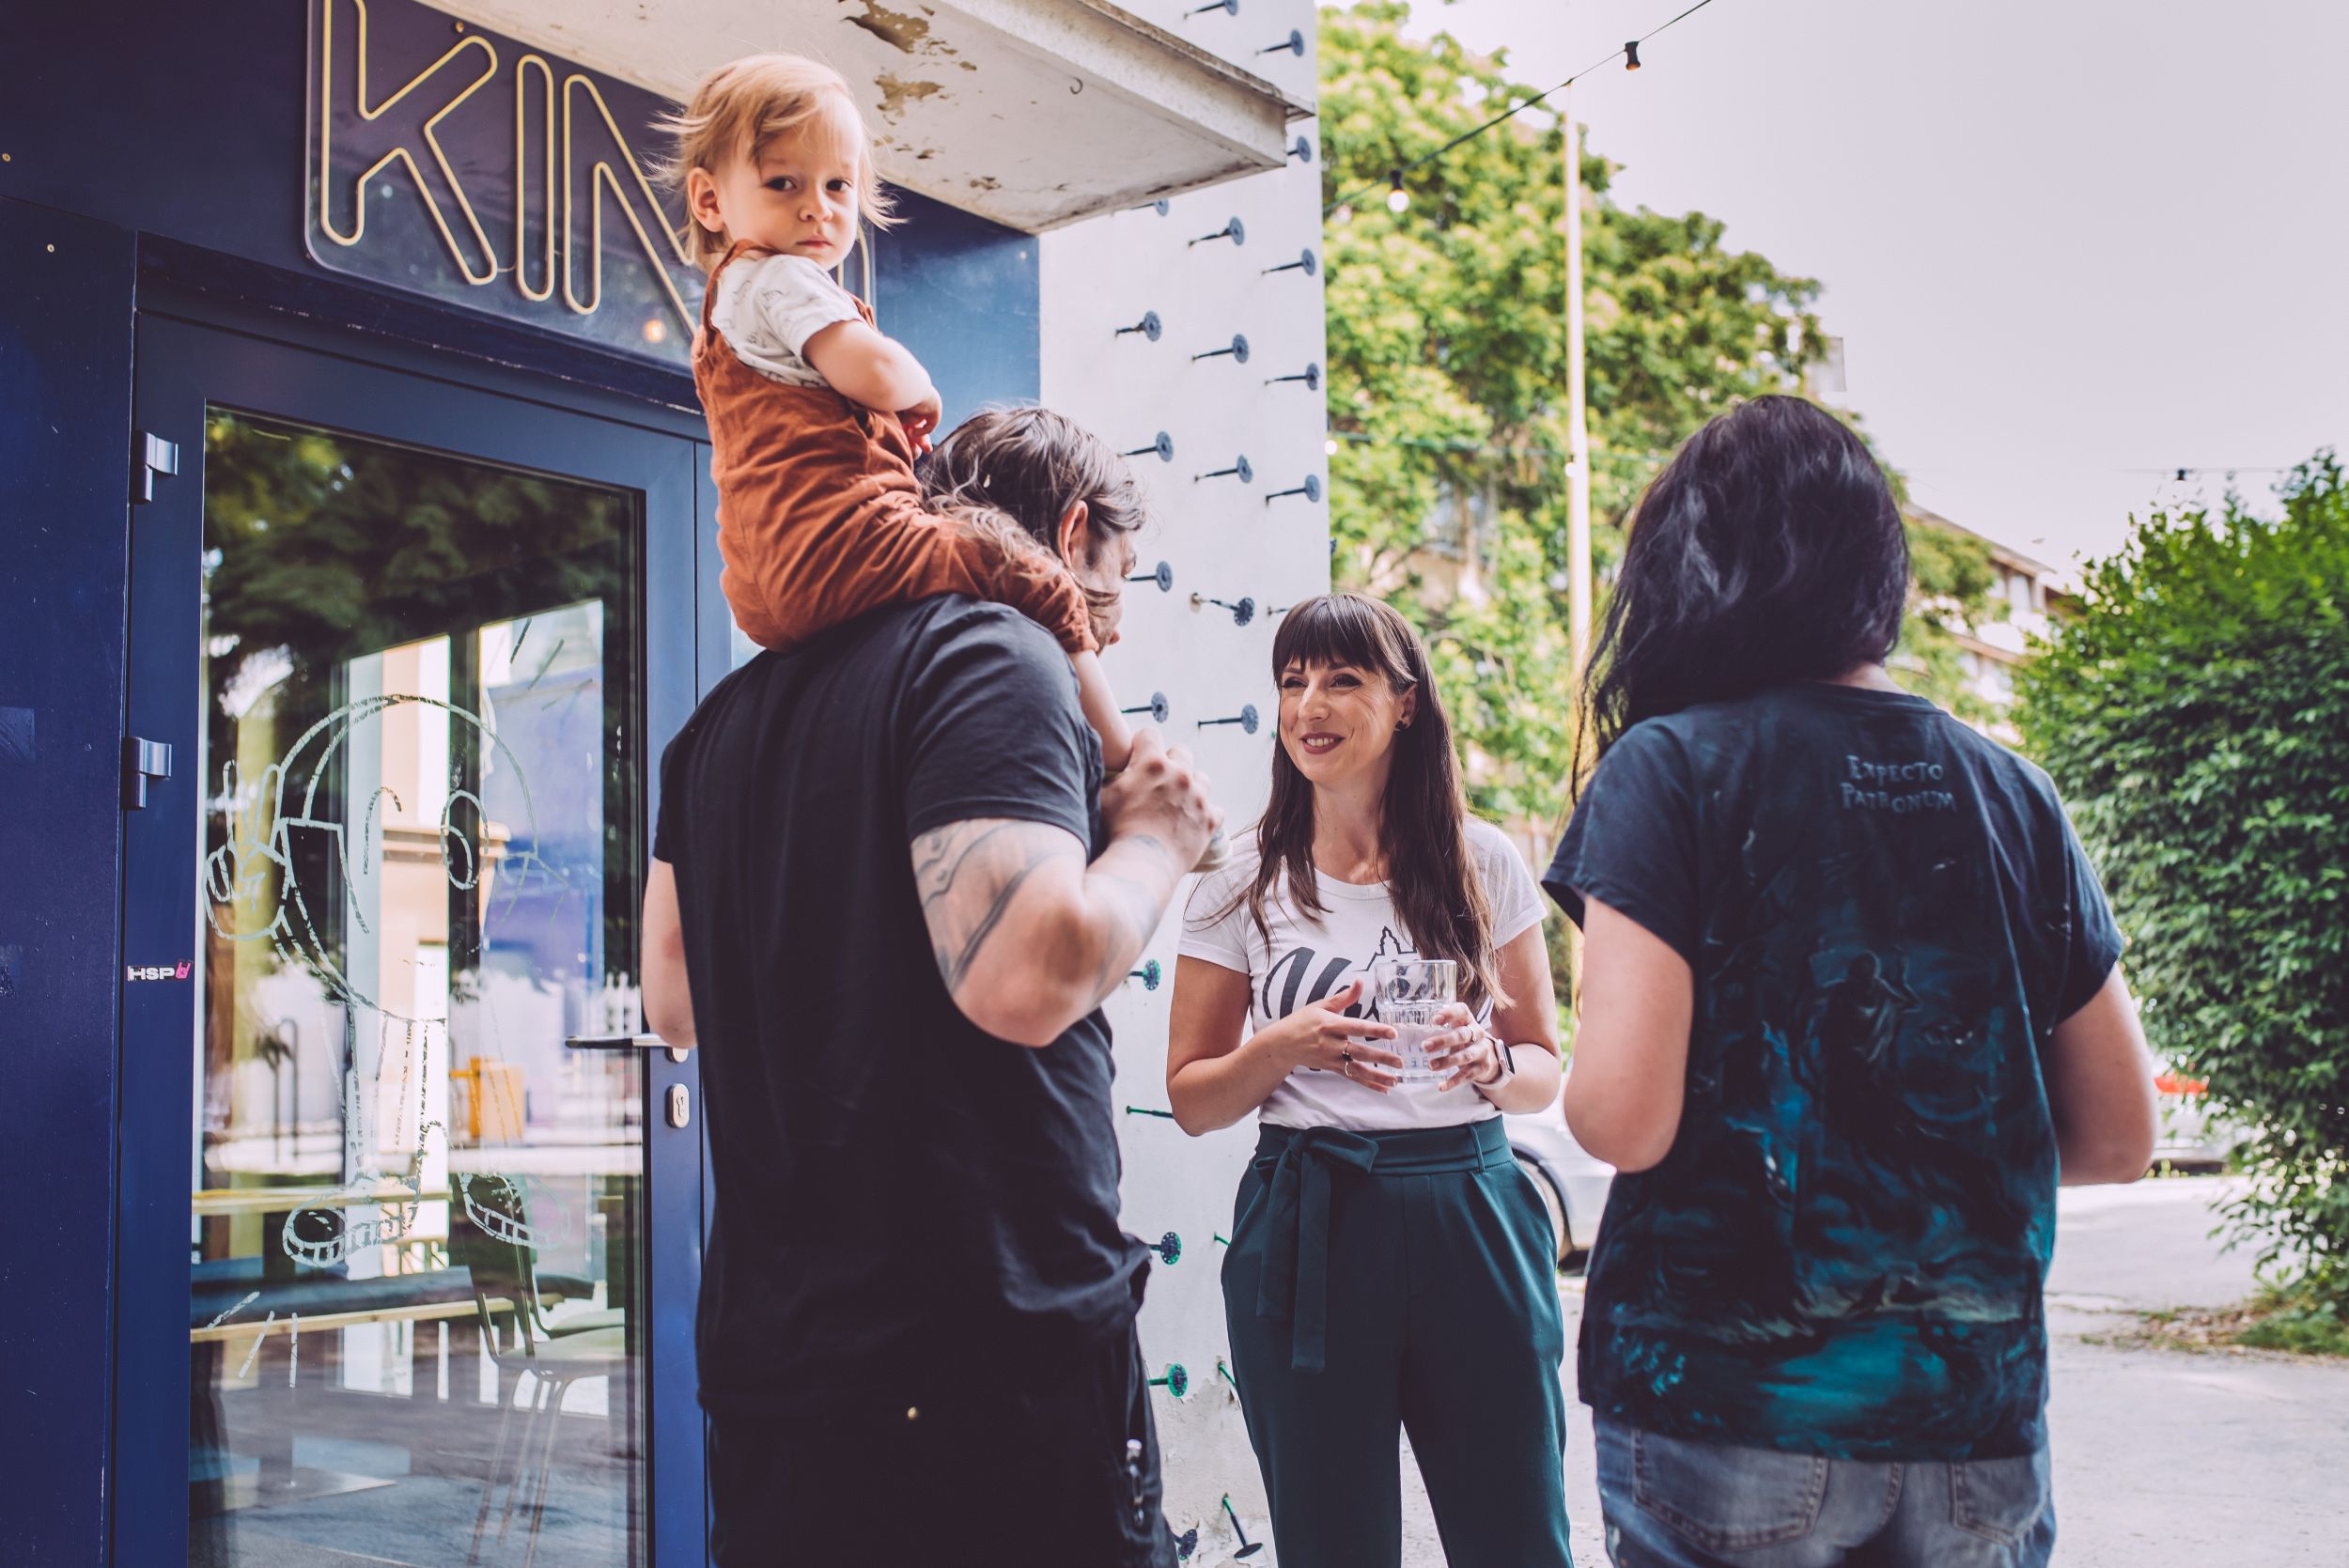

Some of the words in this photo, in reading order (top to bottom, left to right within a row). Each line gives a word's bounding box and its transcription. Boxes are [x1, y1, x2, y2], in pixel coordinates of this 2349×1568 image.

[320, 0, 871, 344] KIN
[1846, 754, 1944, 786] EXPECTO
[1840, 782, 1958, 813] PATRONUM
